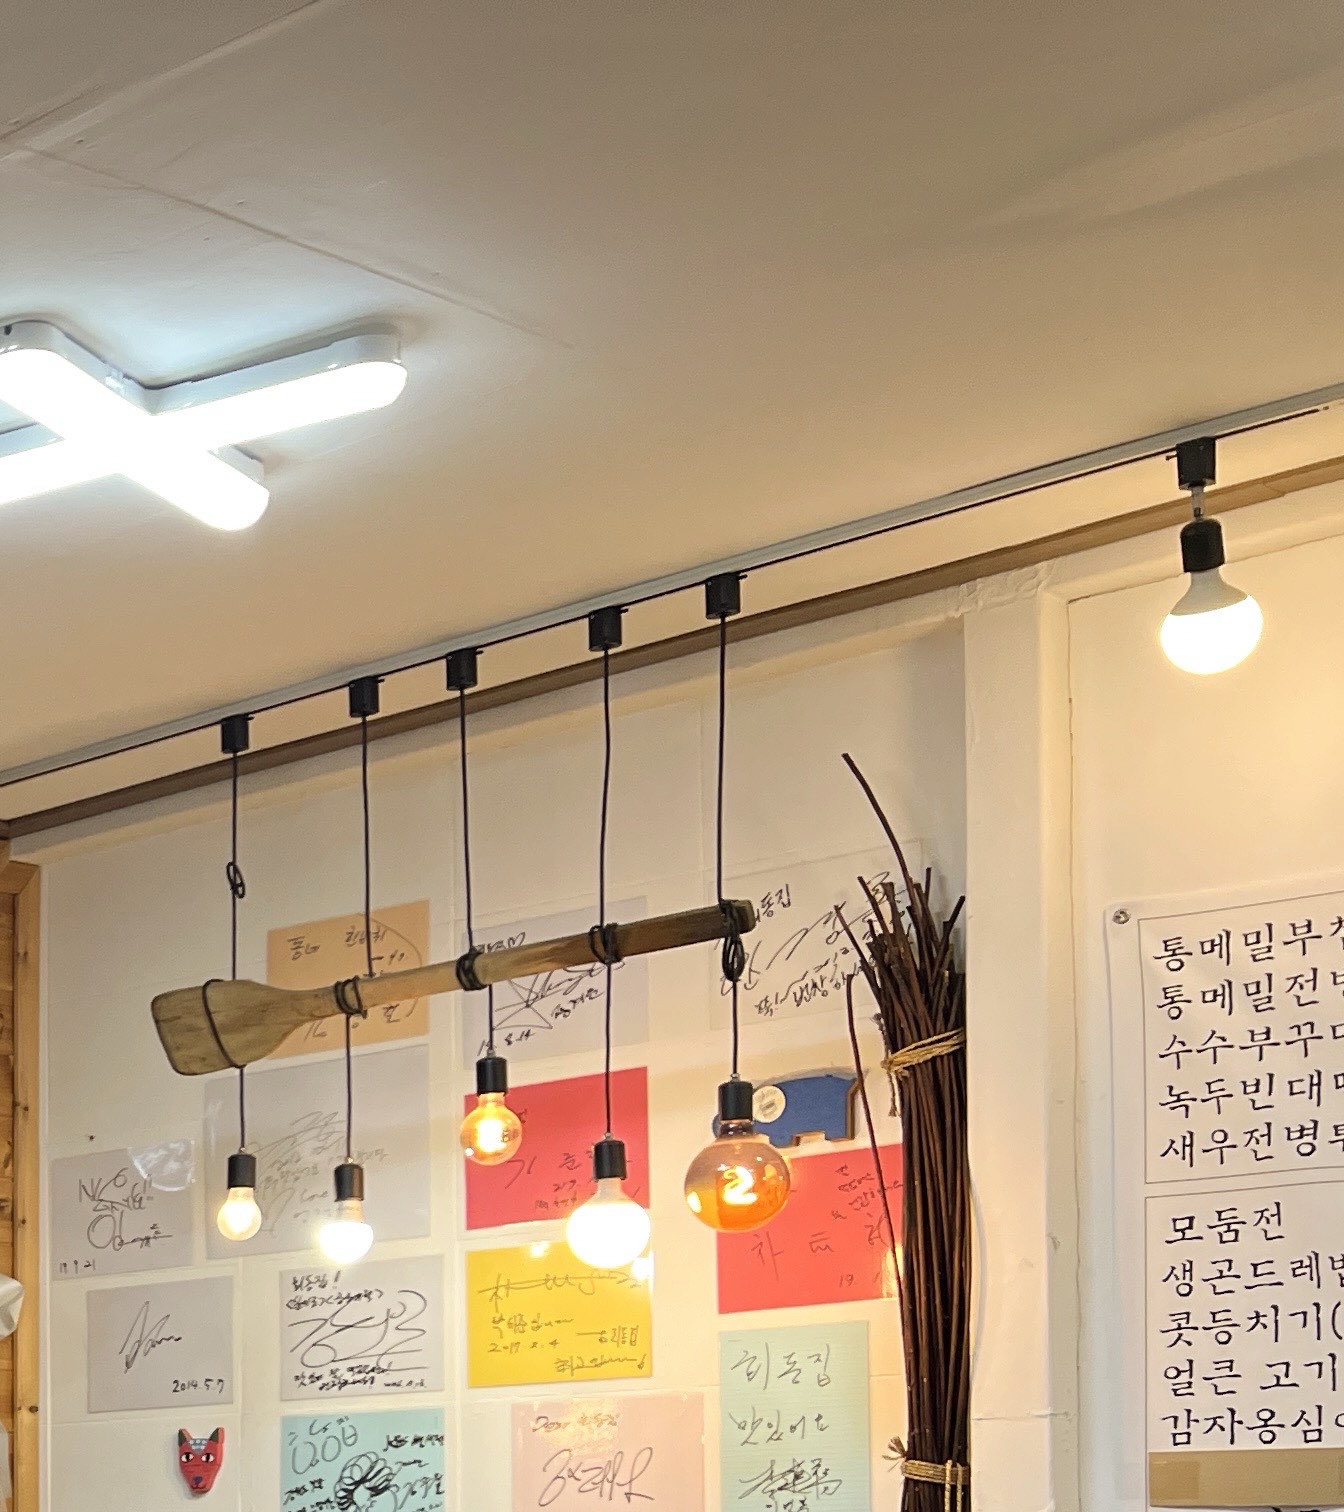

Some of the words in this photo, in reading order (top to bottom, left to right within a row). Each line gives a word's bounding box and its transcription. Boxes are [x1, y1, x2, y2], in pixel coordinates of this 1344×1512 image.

[756, 884, 792, 922] 동집
[1165, 1201, 1284, 1245] 모둠전
[1163, 1358, 1243, 1397] 얼큰
[1259, 1352, 1337, 1391] 고기
